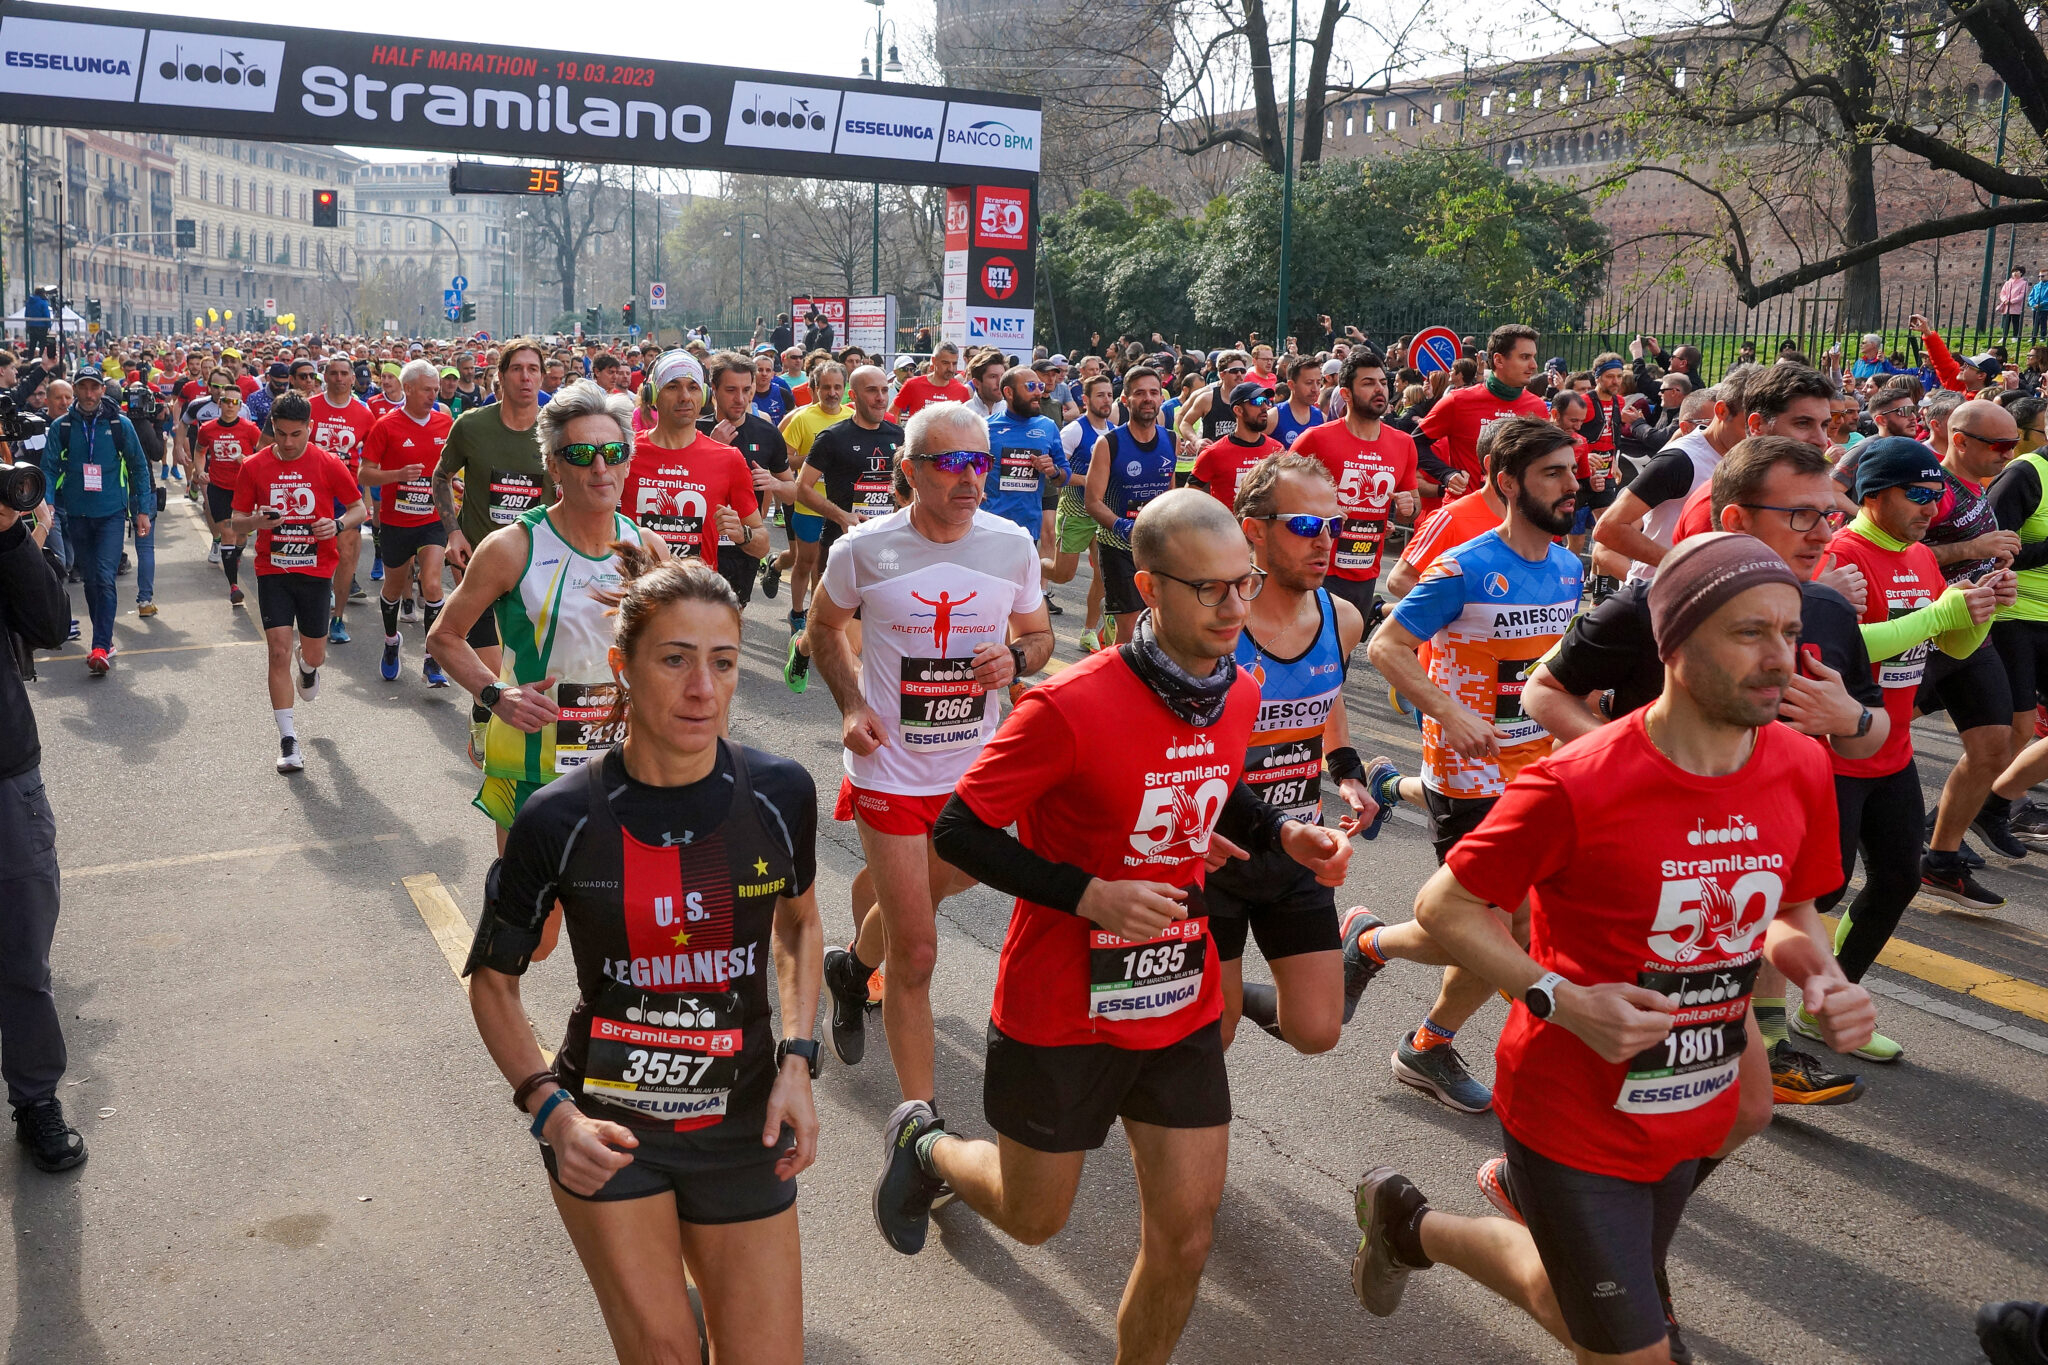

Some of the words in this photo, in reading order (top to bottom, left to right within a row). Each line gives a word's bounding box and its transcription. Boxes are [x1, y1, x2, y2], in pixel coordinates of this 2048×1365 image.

[5, 51, 131, 76] ESSELUNGA
[159, 44, 266, 88] diadora
[372, 45, 423, 68] HALF
[428, 50, 537, 78] MARATHON
[556, 61, 656, 88] 19.03.2023
[301, 65, 712, 143] Stramilano
[741, 93, 826, 132] diadora
[845, 120, 934, 140] ESSELUNGA
[947, 129, 1000, 147] BANCO
[1004, 135, 1033, 151] BPM
[528, 168, 559, 192] 35
[980, 202, 1024, 235] 50
[988, 267, 1012, 280] RTL
[988, 279, 1012, 289] 102.5
[990, 317, 1025, 332] NET
[658, 464, 689, 476] diadora
[1010, 466, 1034, 477] 2164
[1343, 460, 1395, 472] Stramilano
[1921, 469, 1941, 478] FILA
[639, 477, 706, 491] Stramilano
[1338, 468, 1396, 507] 50
[270, 487, 316, 516] 50
[405, 492, 430, 503] 3598
[500, 494, 532, 508] 2097
[864, 492, 889, 504] 2835
[653, 517, 691, 532] diadora
[281, 544, 309, 554] 4747
[1352, 542, 1372, 553] 998
[1738, 560, 1790, 573] energi
[1886, 589, 1930, 599] Stramilano
[892, 623, 934, 634] ATLETICA
[951, 624, 996, 634] TREVIGLIO
[1494, 608, 1575, 628] ARIESCOM
[1494, 625, 1557, 638] ATHLETIC
[905, 683, 969, 693] Stramilano
[563, 709, 611, 718] Stramila
[924, 697, 974, 721] 1866
[1257, 697, 1337, 721] IESCOM
[904, 728, 979, 745] ESSELUNGA
[1166, 733, 1214, 760] diadora
[1263, 743, 1312, 768] diadora
[1145, 764, 1230, 787] Stramilano
[1247, 767, 1305, 782] Stramilano
[1262, 779, 1308, 806] 1851
[1129, 778, 1229, 856] 50
[1687, 815, 1759, 846] diadora
[1661, 854, 1783, 878] Stramilano
[738, 876, 786, 899] RUNNERS
[654, 895, 681, 927] U.
[686, 891, 711, 922] S.
[1647, 870, 1784, 964] 50
[603, 941, 758, 988] LEGNANESE
[1123, 942, 1188, 981] 1635
[1644, 960, 1675, 972] RUN
[1097, 984, 1195, 1014] ESSELUNGA
[1667, 973, 1742, 1006] diadora
[625, 994, 717, 1028] diadora
[600, 1022, 705, 1046] Stramilano
[1664, 1023, 1727, 1068] 1801
[622, 1049, 715, 1086] 3557
[655, 1086, 688, 1094] MARATHON
[1627, 1069, 1735, 1104] ESSELUNGA
